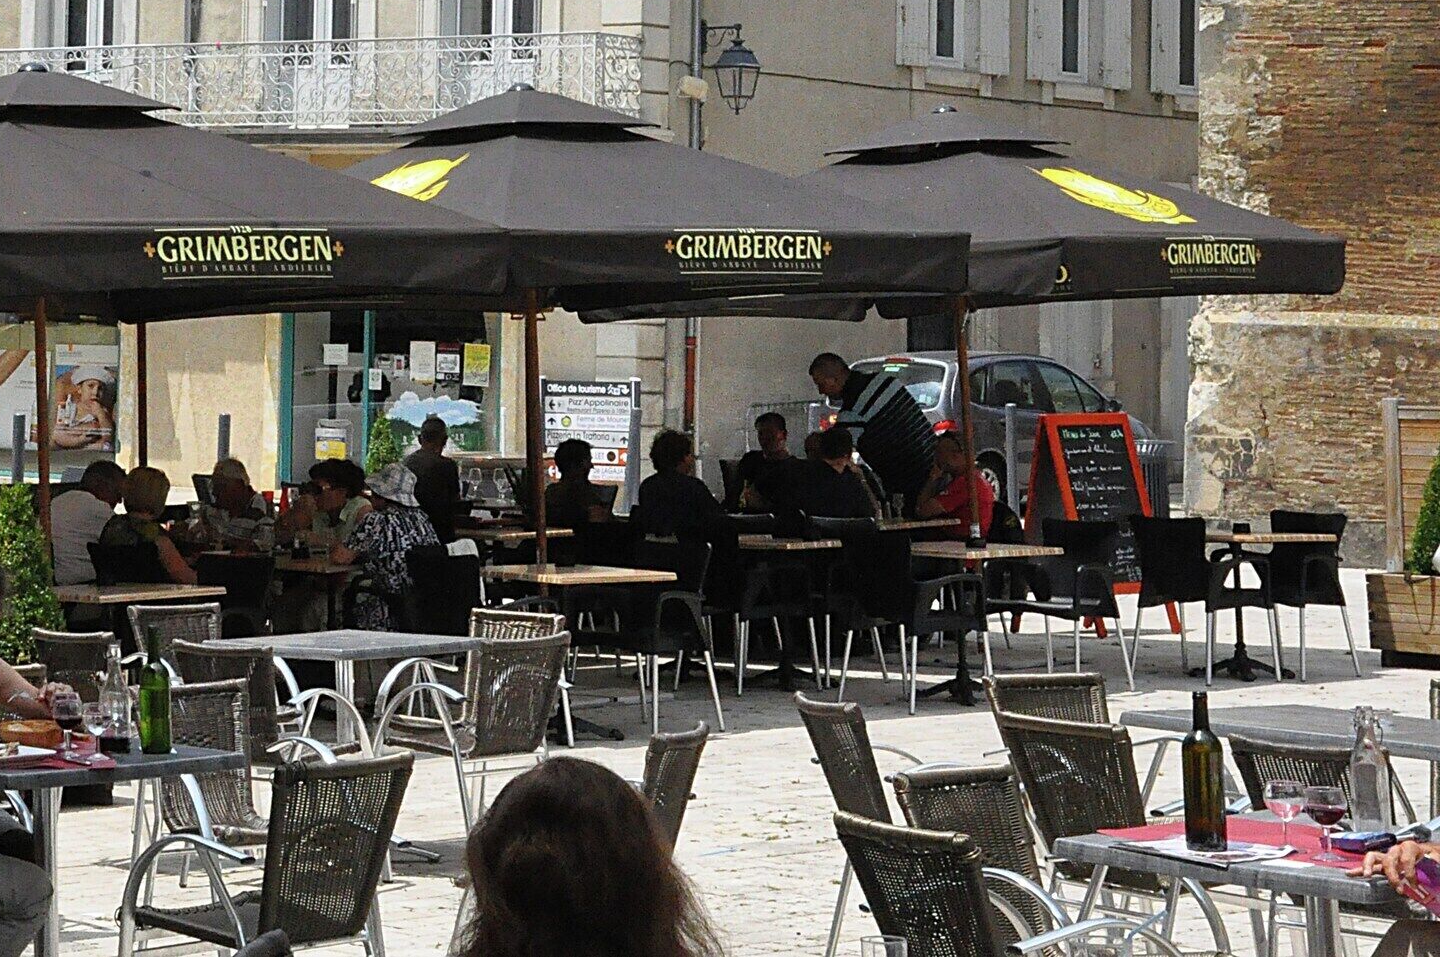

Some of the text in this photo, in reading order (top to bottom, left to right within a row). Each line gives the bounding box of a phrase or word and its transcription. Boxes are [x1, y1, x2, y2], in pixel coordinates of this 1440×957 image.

[157, 235, 333, 263] GRIMBERGEN
[675, 234, 822, 260] GRIMBERGEN
[1167, 243, 1256, 265] GRIMBERGEN
[546, 384, 606, 394] Office de tourisme
